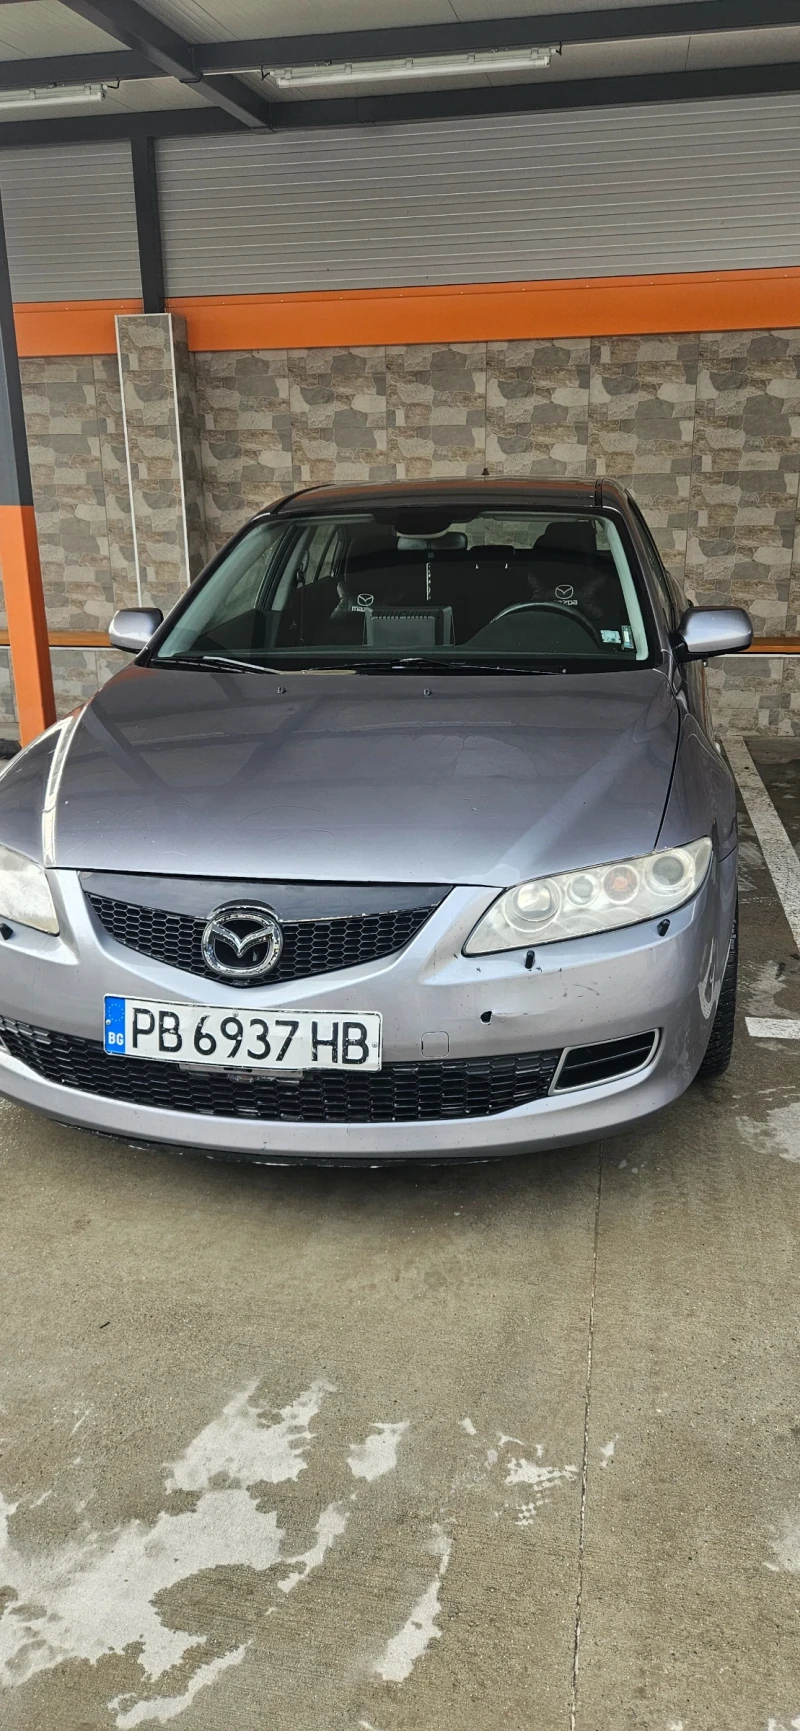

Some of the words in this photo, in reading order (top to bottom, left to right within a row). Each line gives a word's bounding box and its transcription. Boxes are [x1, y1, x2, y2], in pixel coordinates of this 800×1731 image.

[108, 1031, 124, 1046] BG
[132, 1007, 183, 1052] PB
[193, 1014, 299, 1061] 6937
[311, 1021, 369, 1064] HB
